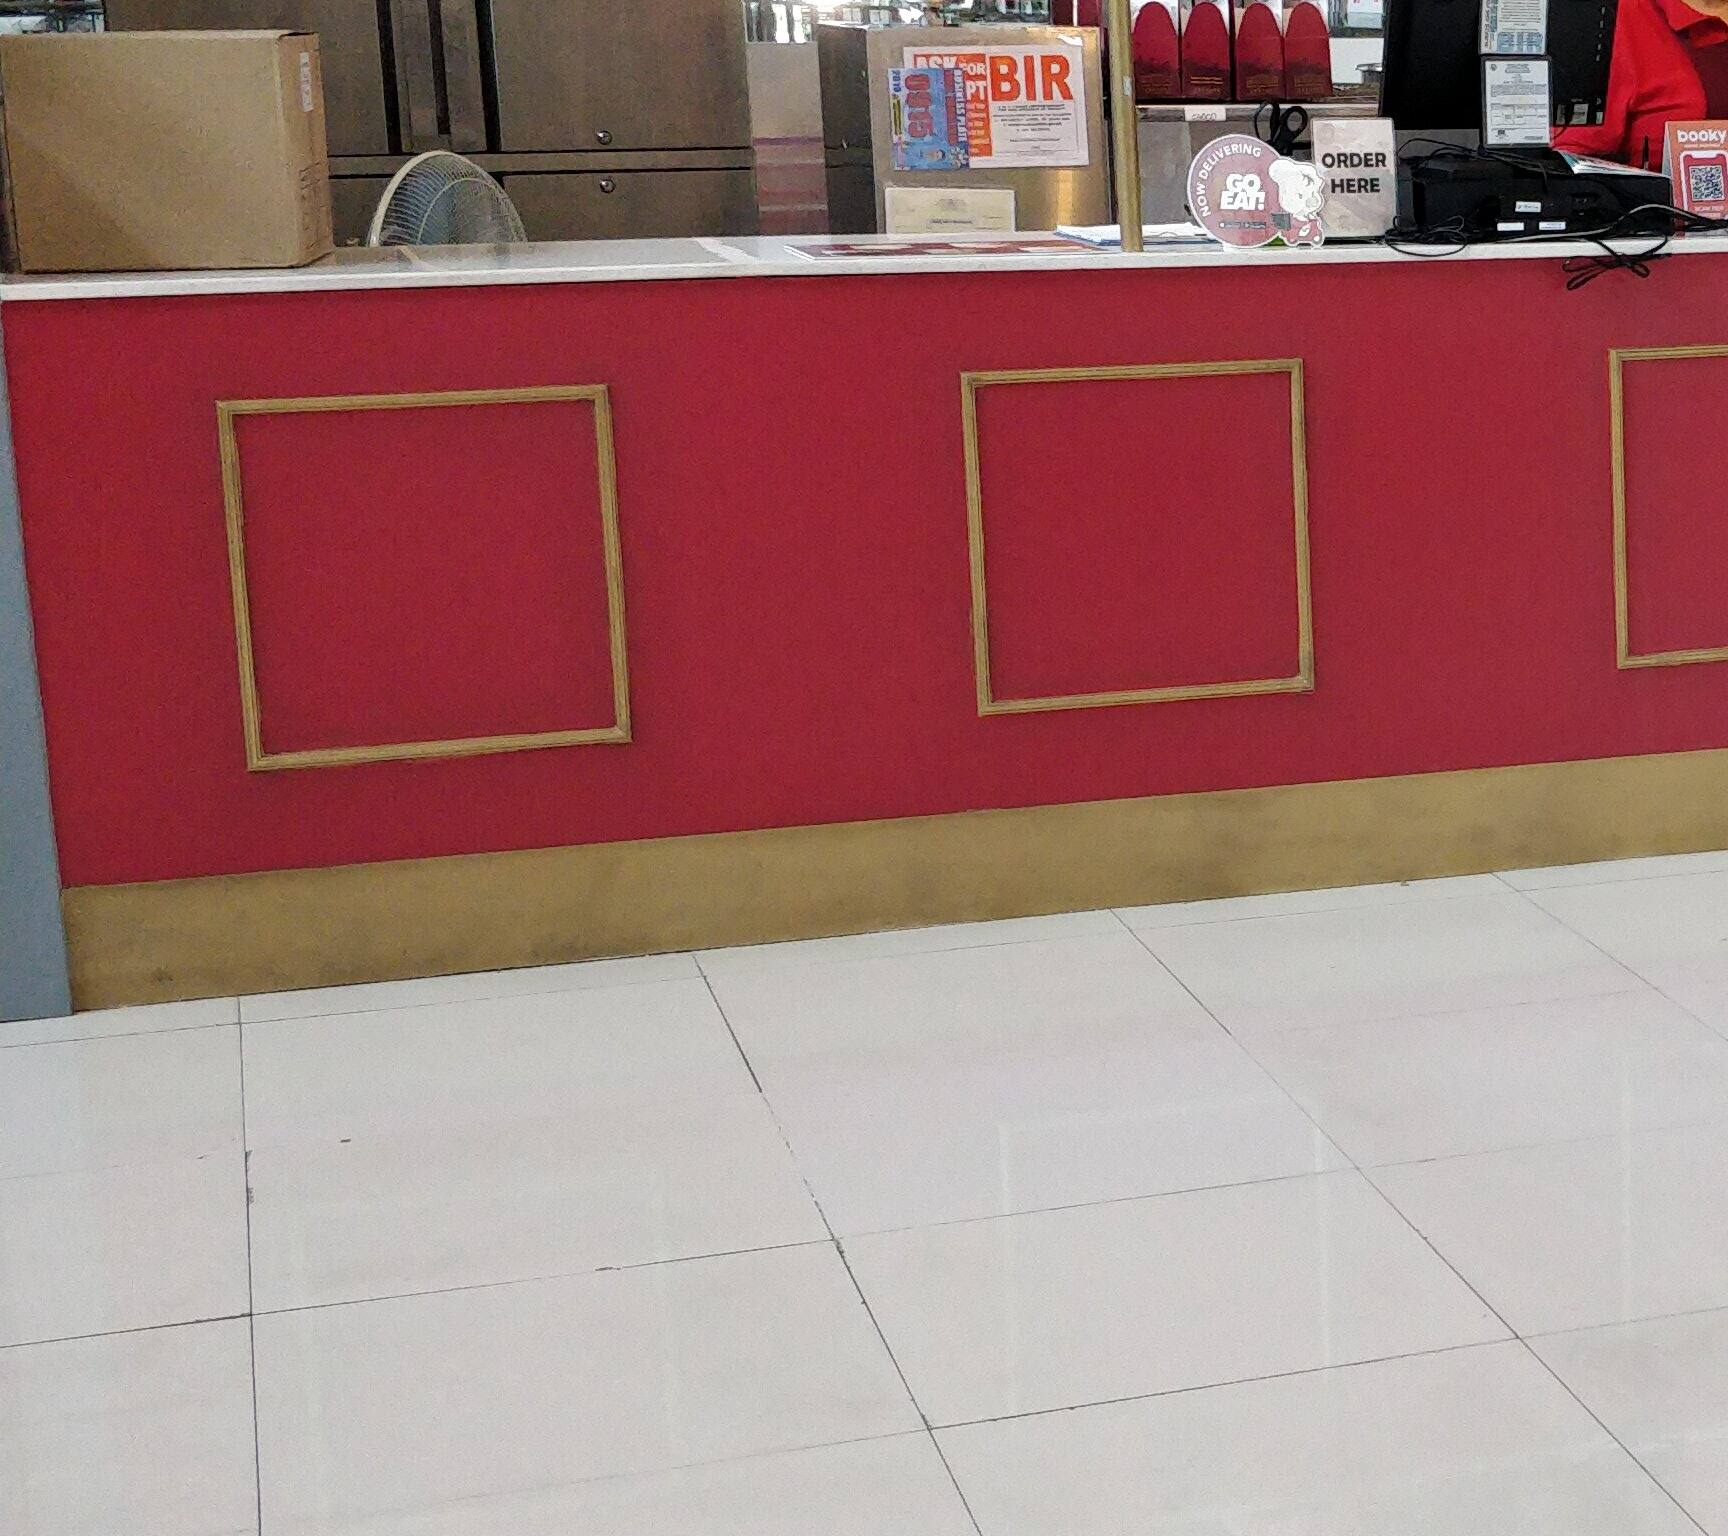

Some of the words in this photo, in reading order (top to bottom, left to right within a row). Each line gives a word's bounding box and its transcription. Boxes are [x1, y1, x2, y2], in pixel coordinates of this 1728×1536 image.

[989, 54, 1073, 101] BIR
[1677, 129, 1727, 144] booky
[1199, 143, 1262, 181] DELIVERING
[1321, 152, 1387, 168] ORDER
[1226, 173, 1262, 191] GO
[1331, 177, 1381, 193] HERE
[1197, 183, 1211, 217] NOW
[1220, 190, 1265, 210] EAT!
